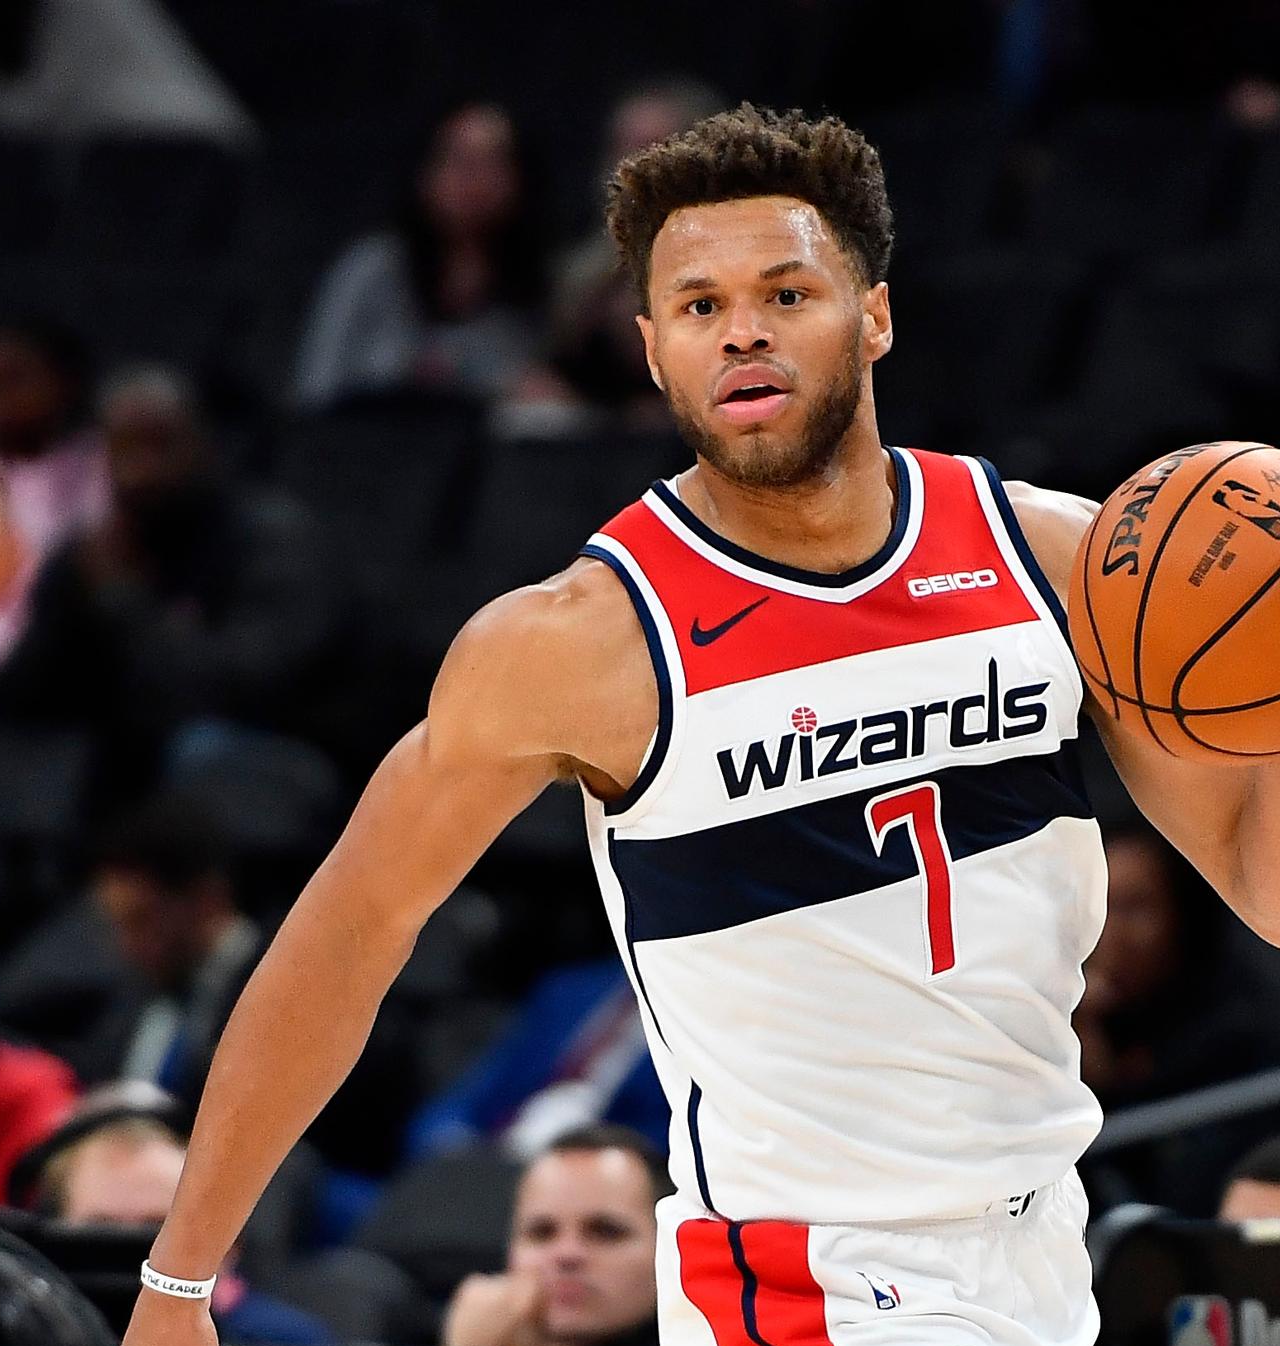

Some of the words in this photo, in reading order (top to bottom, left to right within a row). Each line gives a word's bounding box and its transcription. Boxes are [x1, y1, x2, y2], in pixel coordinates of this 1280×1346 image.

[908, 568, 999, 599] GEICO
[717, 656, 1051, 801] wizards
[865, 780, 957, 982] 7
[162, 1280, 203, 1295] LEADER
